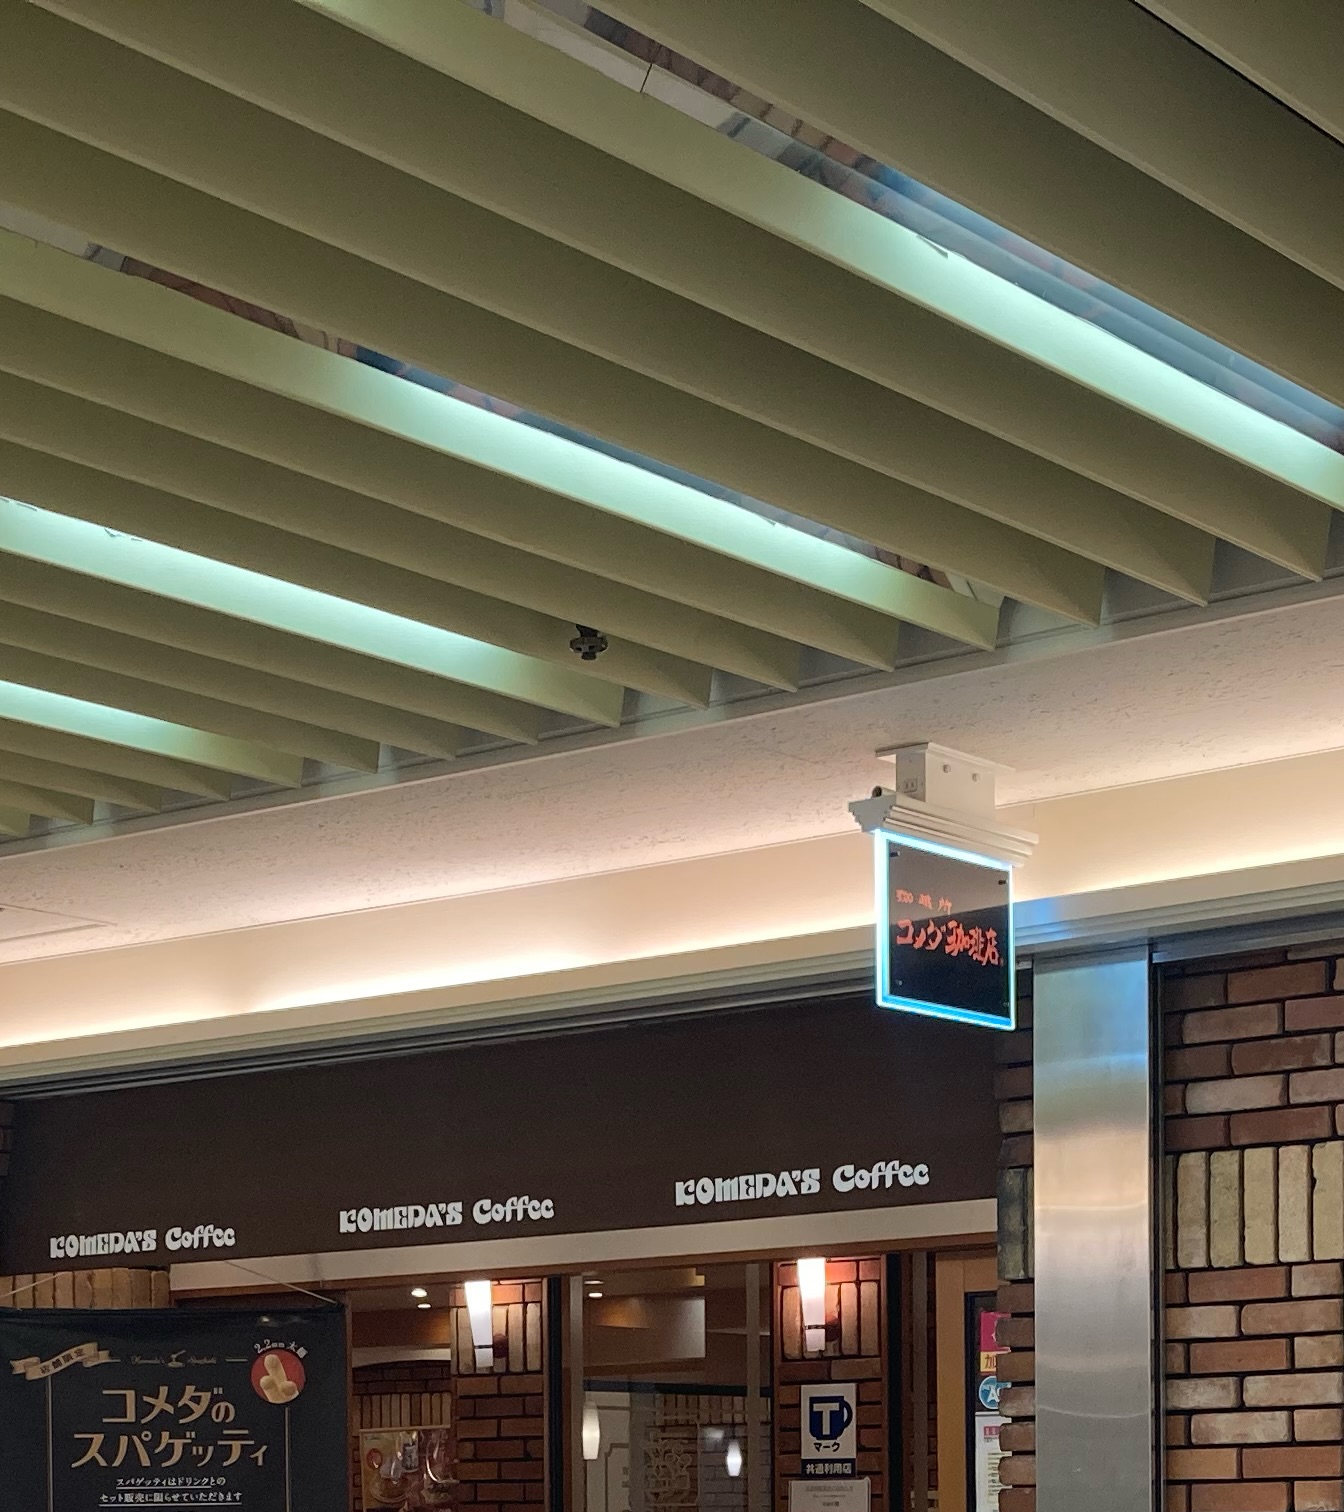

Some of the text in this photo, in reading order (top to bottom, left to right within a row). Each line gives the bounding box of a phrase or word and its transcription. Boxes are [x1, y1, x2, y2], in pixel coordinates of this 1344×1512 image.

[896, 919, 1000, 966] コメダ珈琲店
[675, 1160, 930, 1207] KOMEDA'S Coffee
[339, 1195, 555, 1234] KOMEDA'S Coffee
[50, 1224, 236, 1259] KOMEDA'S Coffee
[101, 1385, 236, 1425] コメダの
[71, 1428, 269, 1469] スパゲッティ
[813, 1442, 840, 1452] マーク
[116, 1476, 226, 1486] スパゲッティはドリンクとの
